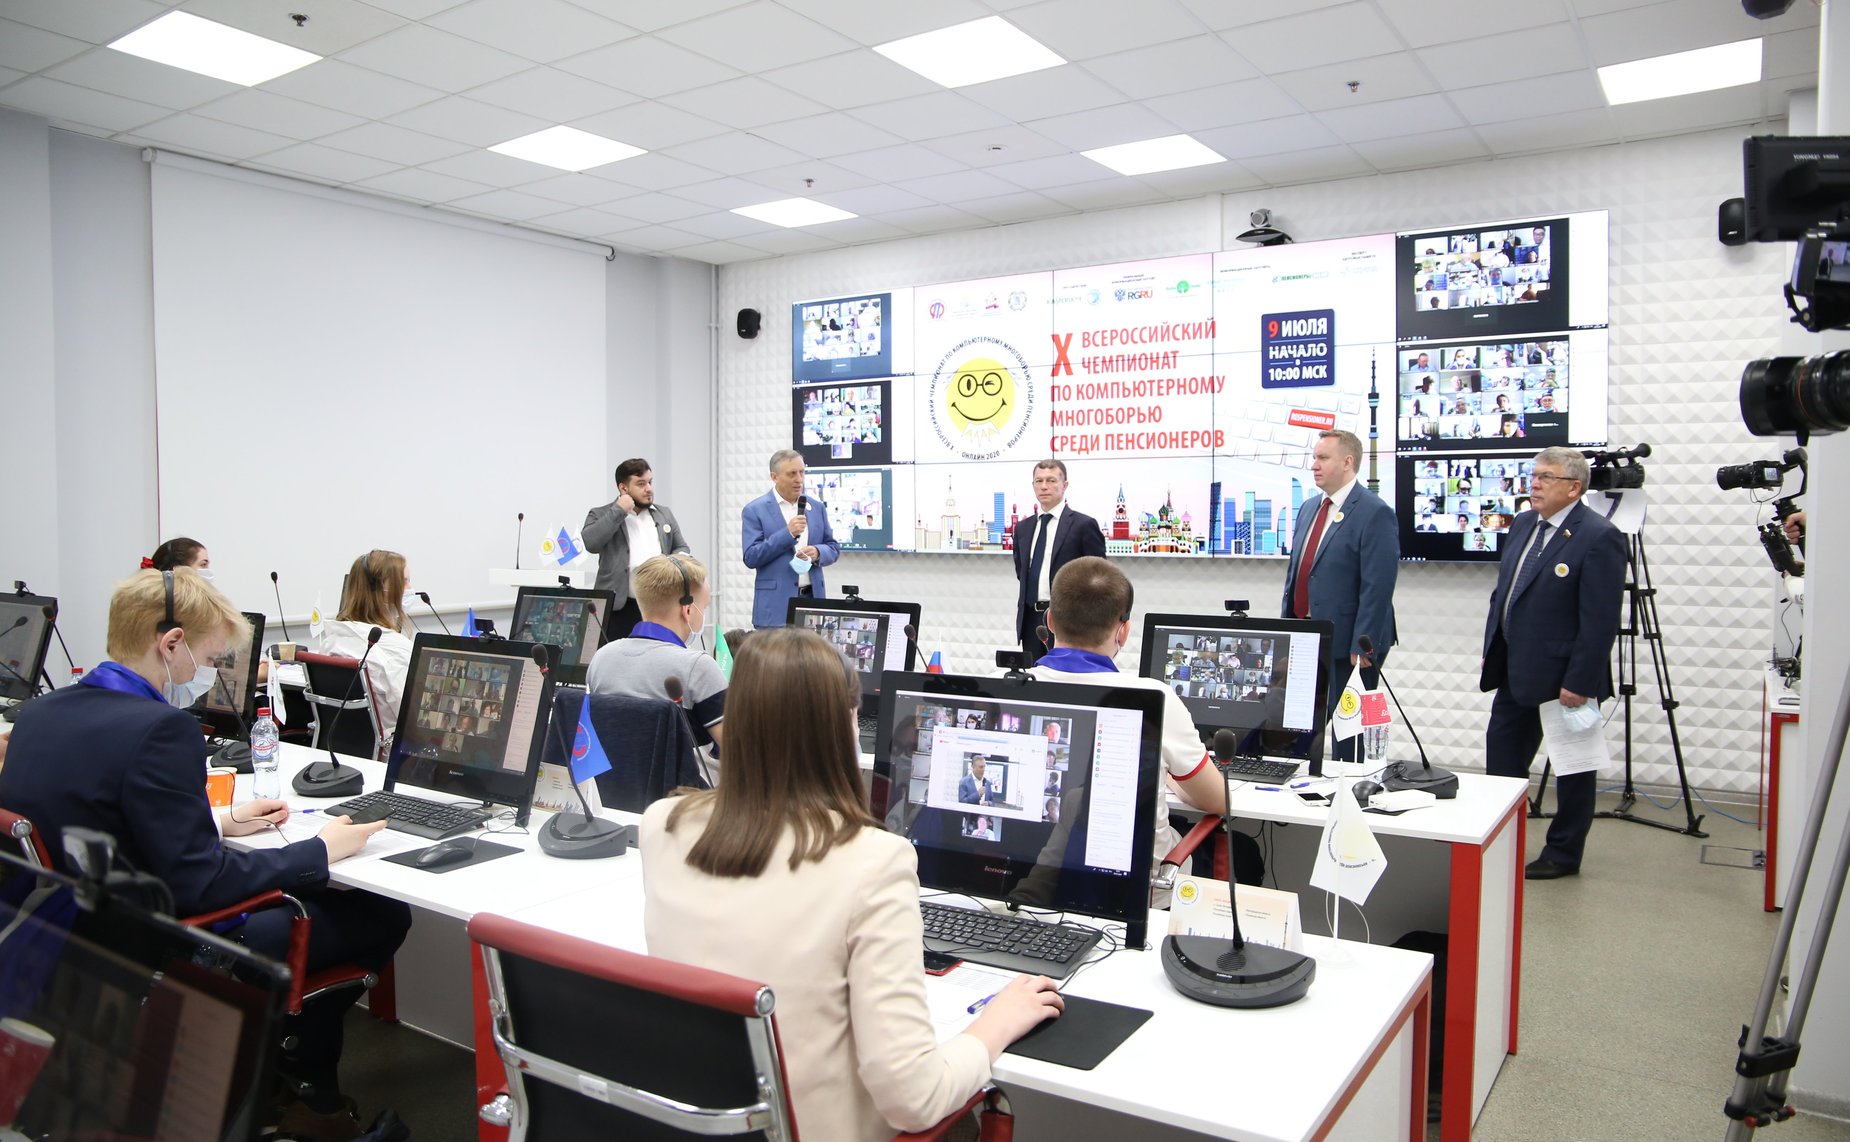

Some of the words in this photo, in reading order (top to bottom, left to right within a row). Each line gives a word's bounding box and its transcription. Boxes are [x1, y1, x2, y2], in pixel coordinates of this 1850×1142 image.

[1127, 289, 1153, 300] RGRU
[1082, 317, 1217, 348] ВСЕРОССИЙСКИЙ
[1268, 320, 1279, 338] 9
[1281, 318, 1328, 337] ИЮЛЯ
[1082, 350, 1179, 375] ЧЕМПИОНАТ
[1268, 343, 1328, 359] НАЧАЛО
[1268, 366, 1301, 381] 10:00
[1302, 365, 1328, 379] МСК
[1050, 385, 1072, 402] ПО
[1076, 375, 1226, 401] КОМПЬЮТЕРНОМУ
[1050, 405, 1163, 427] МНОГОБОРЬЮ
[1050, 434, 1100, 455] СРЕДИ
[1105, 429, 1225, 451] ПЕНСИОНЕРОВ
[1604, 491, 1624, 520] 7
